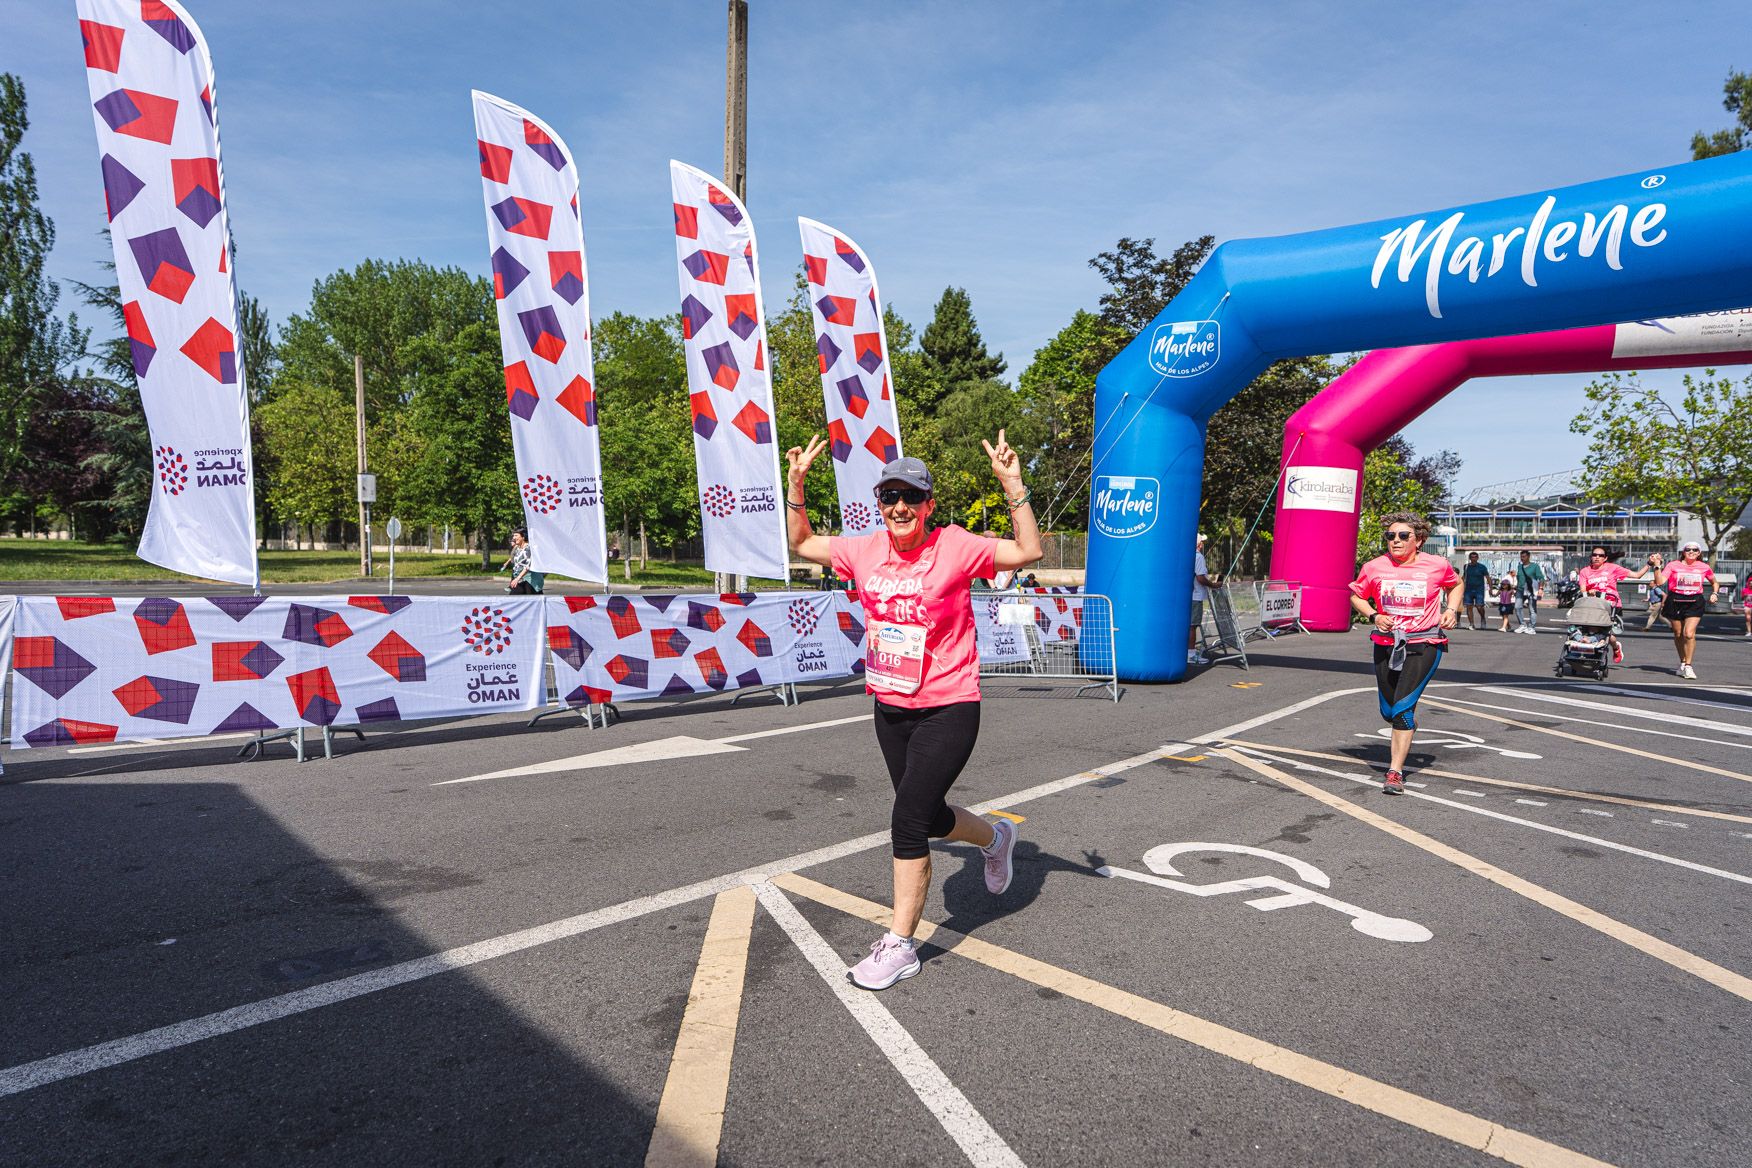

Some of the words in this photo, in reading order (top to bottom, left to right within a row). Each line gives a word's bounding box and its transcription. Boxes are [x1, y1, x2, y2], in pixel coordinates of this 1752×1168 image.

[1371, 195, 1667, 319] Marlene
[1154, 334, 1215, 363] Marlene
[1191, 361, 1210, 373] ALPES
[1300, 480, 1354, 495] kirolaraba
[1096, 489, 1153, 520] Marlene
[1127, 522, 1146, 533] ALPES
[1266, 600, 1273, 611] EL
[1274, 599, 1295, 611] CORREO
[794, 641, 823, 650] Experience
[879, 652, 902, 666] 016
[466, 662, 517, 673] Experience
[798, 661, 828, 673] OMAN
[468, 687, 520, 703] OMAN
